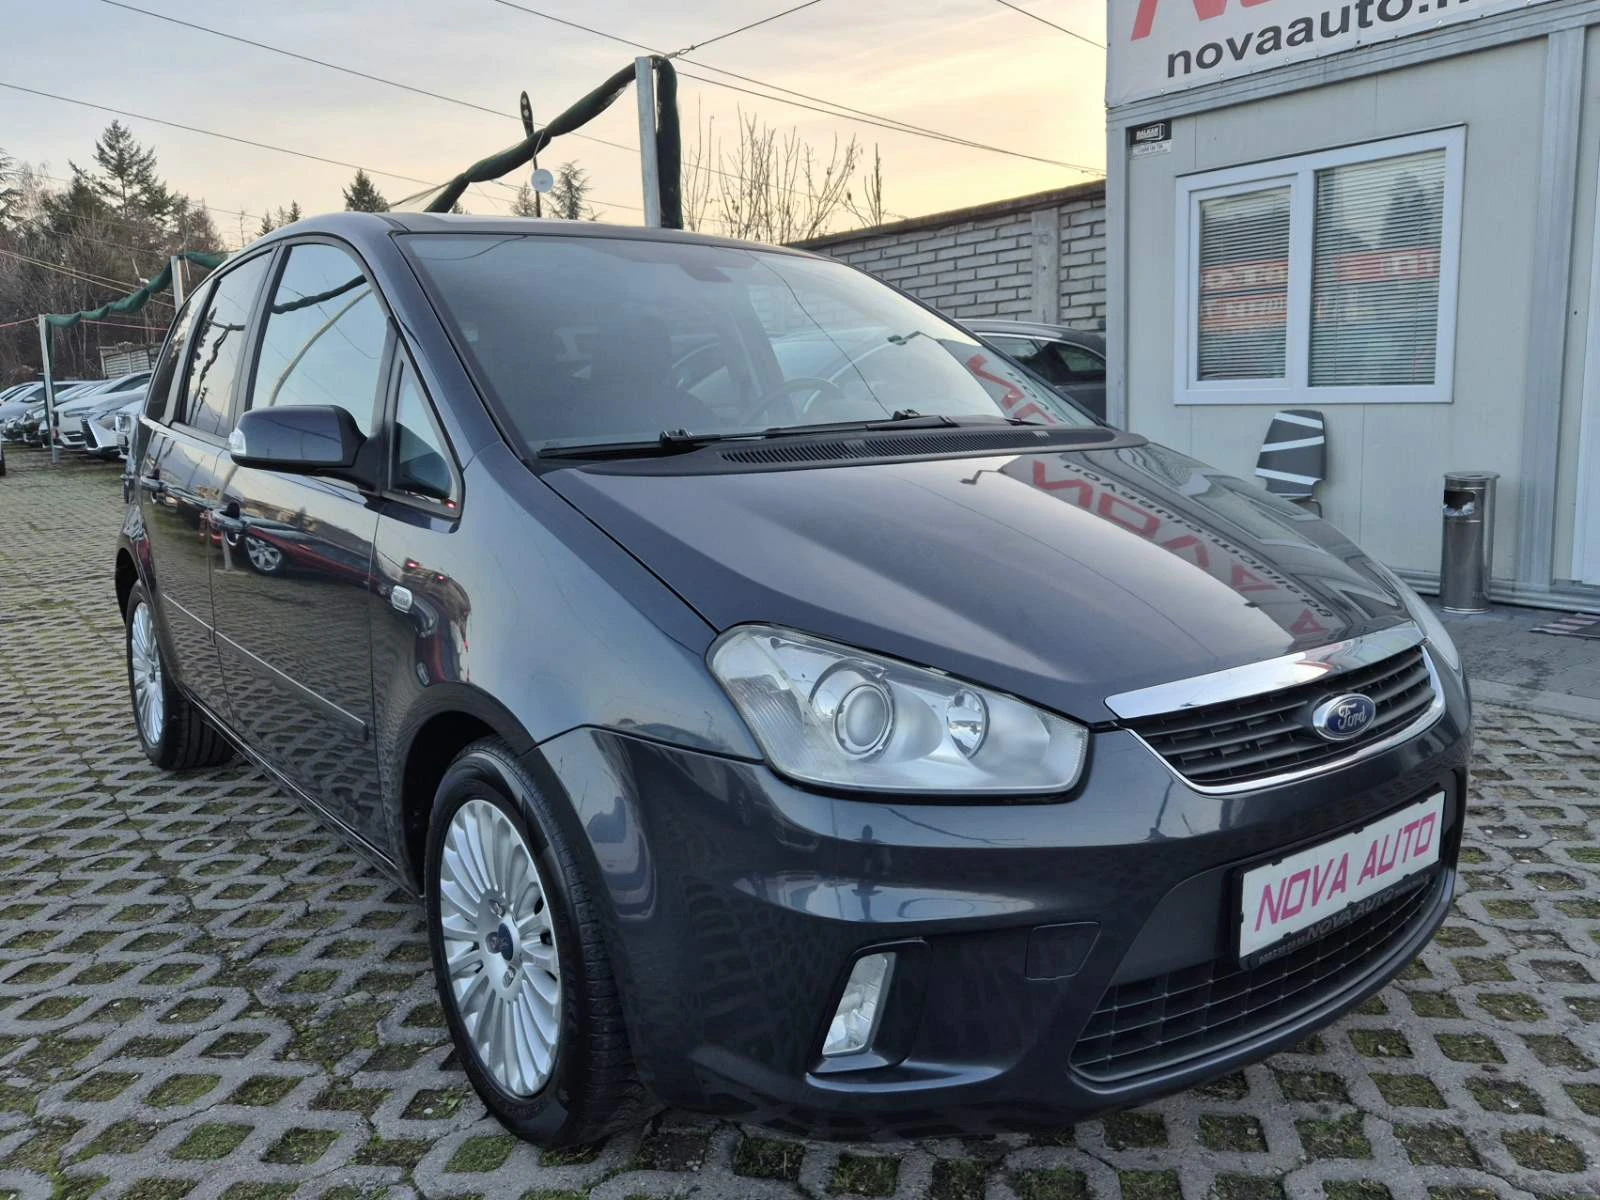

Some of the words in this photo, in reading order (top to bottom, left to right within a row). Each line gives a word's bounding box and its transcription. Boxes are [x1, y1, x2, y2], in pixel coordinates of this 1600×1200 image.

[1337, 702, 1367, 730] Ford
[1254, 852, 1350, 933] NOVA
[1356, 812, 1436, 886] AUTO
